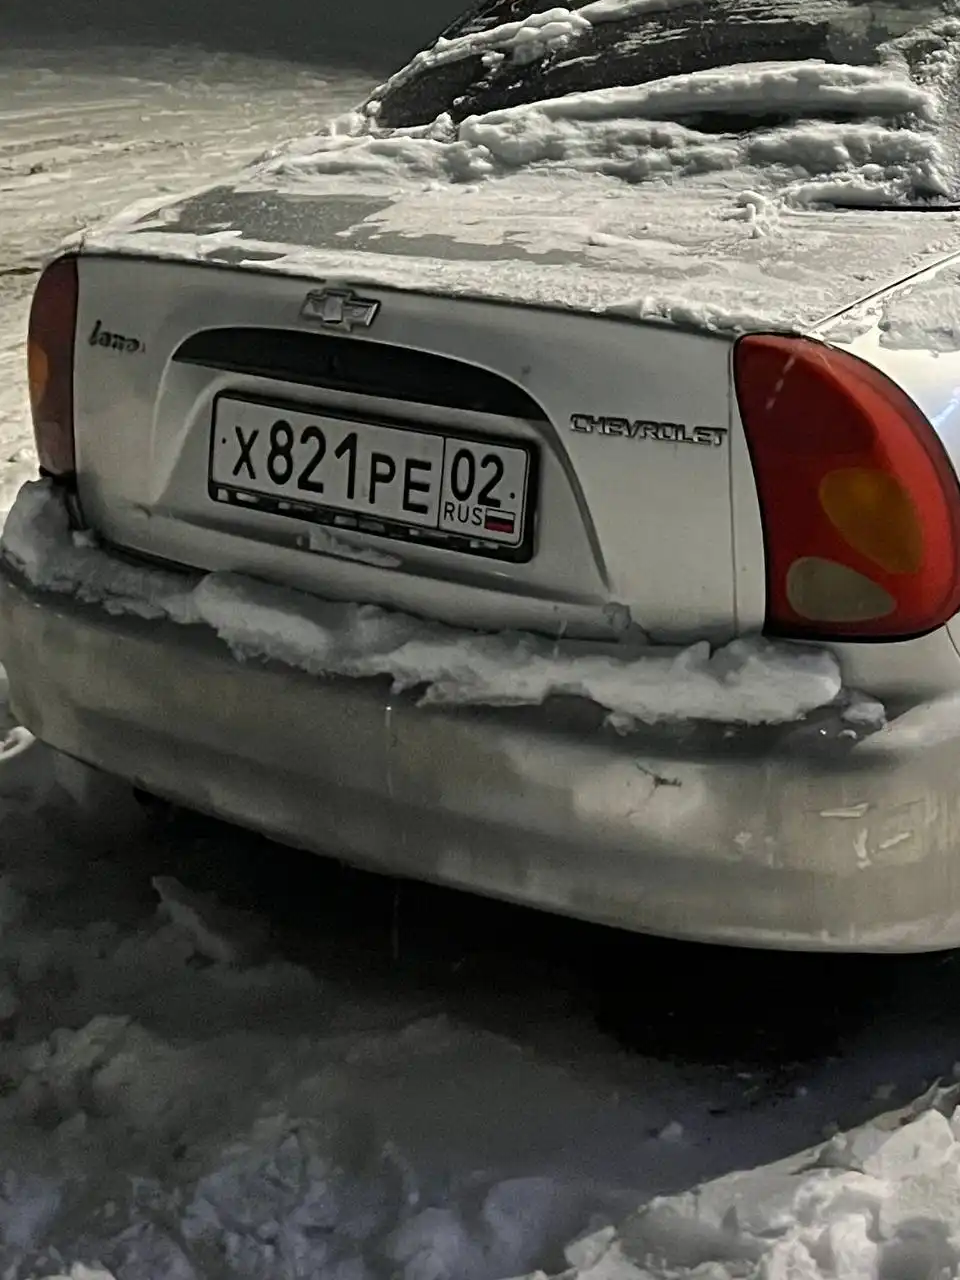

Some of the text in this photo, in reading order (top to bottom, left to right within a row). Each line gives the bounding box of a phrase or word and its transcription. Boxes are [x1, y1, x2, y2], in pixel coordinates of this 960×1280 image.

[569, 413, 728, 447] CHEVROLET
[450, 448, 506, 508] 02
[443, 501, 483, 527] RUS
